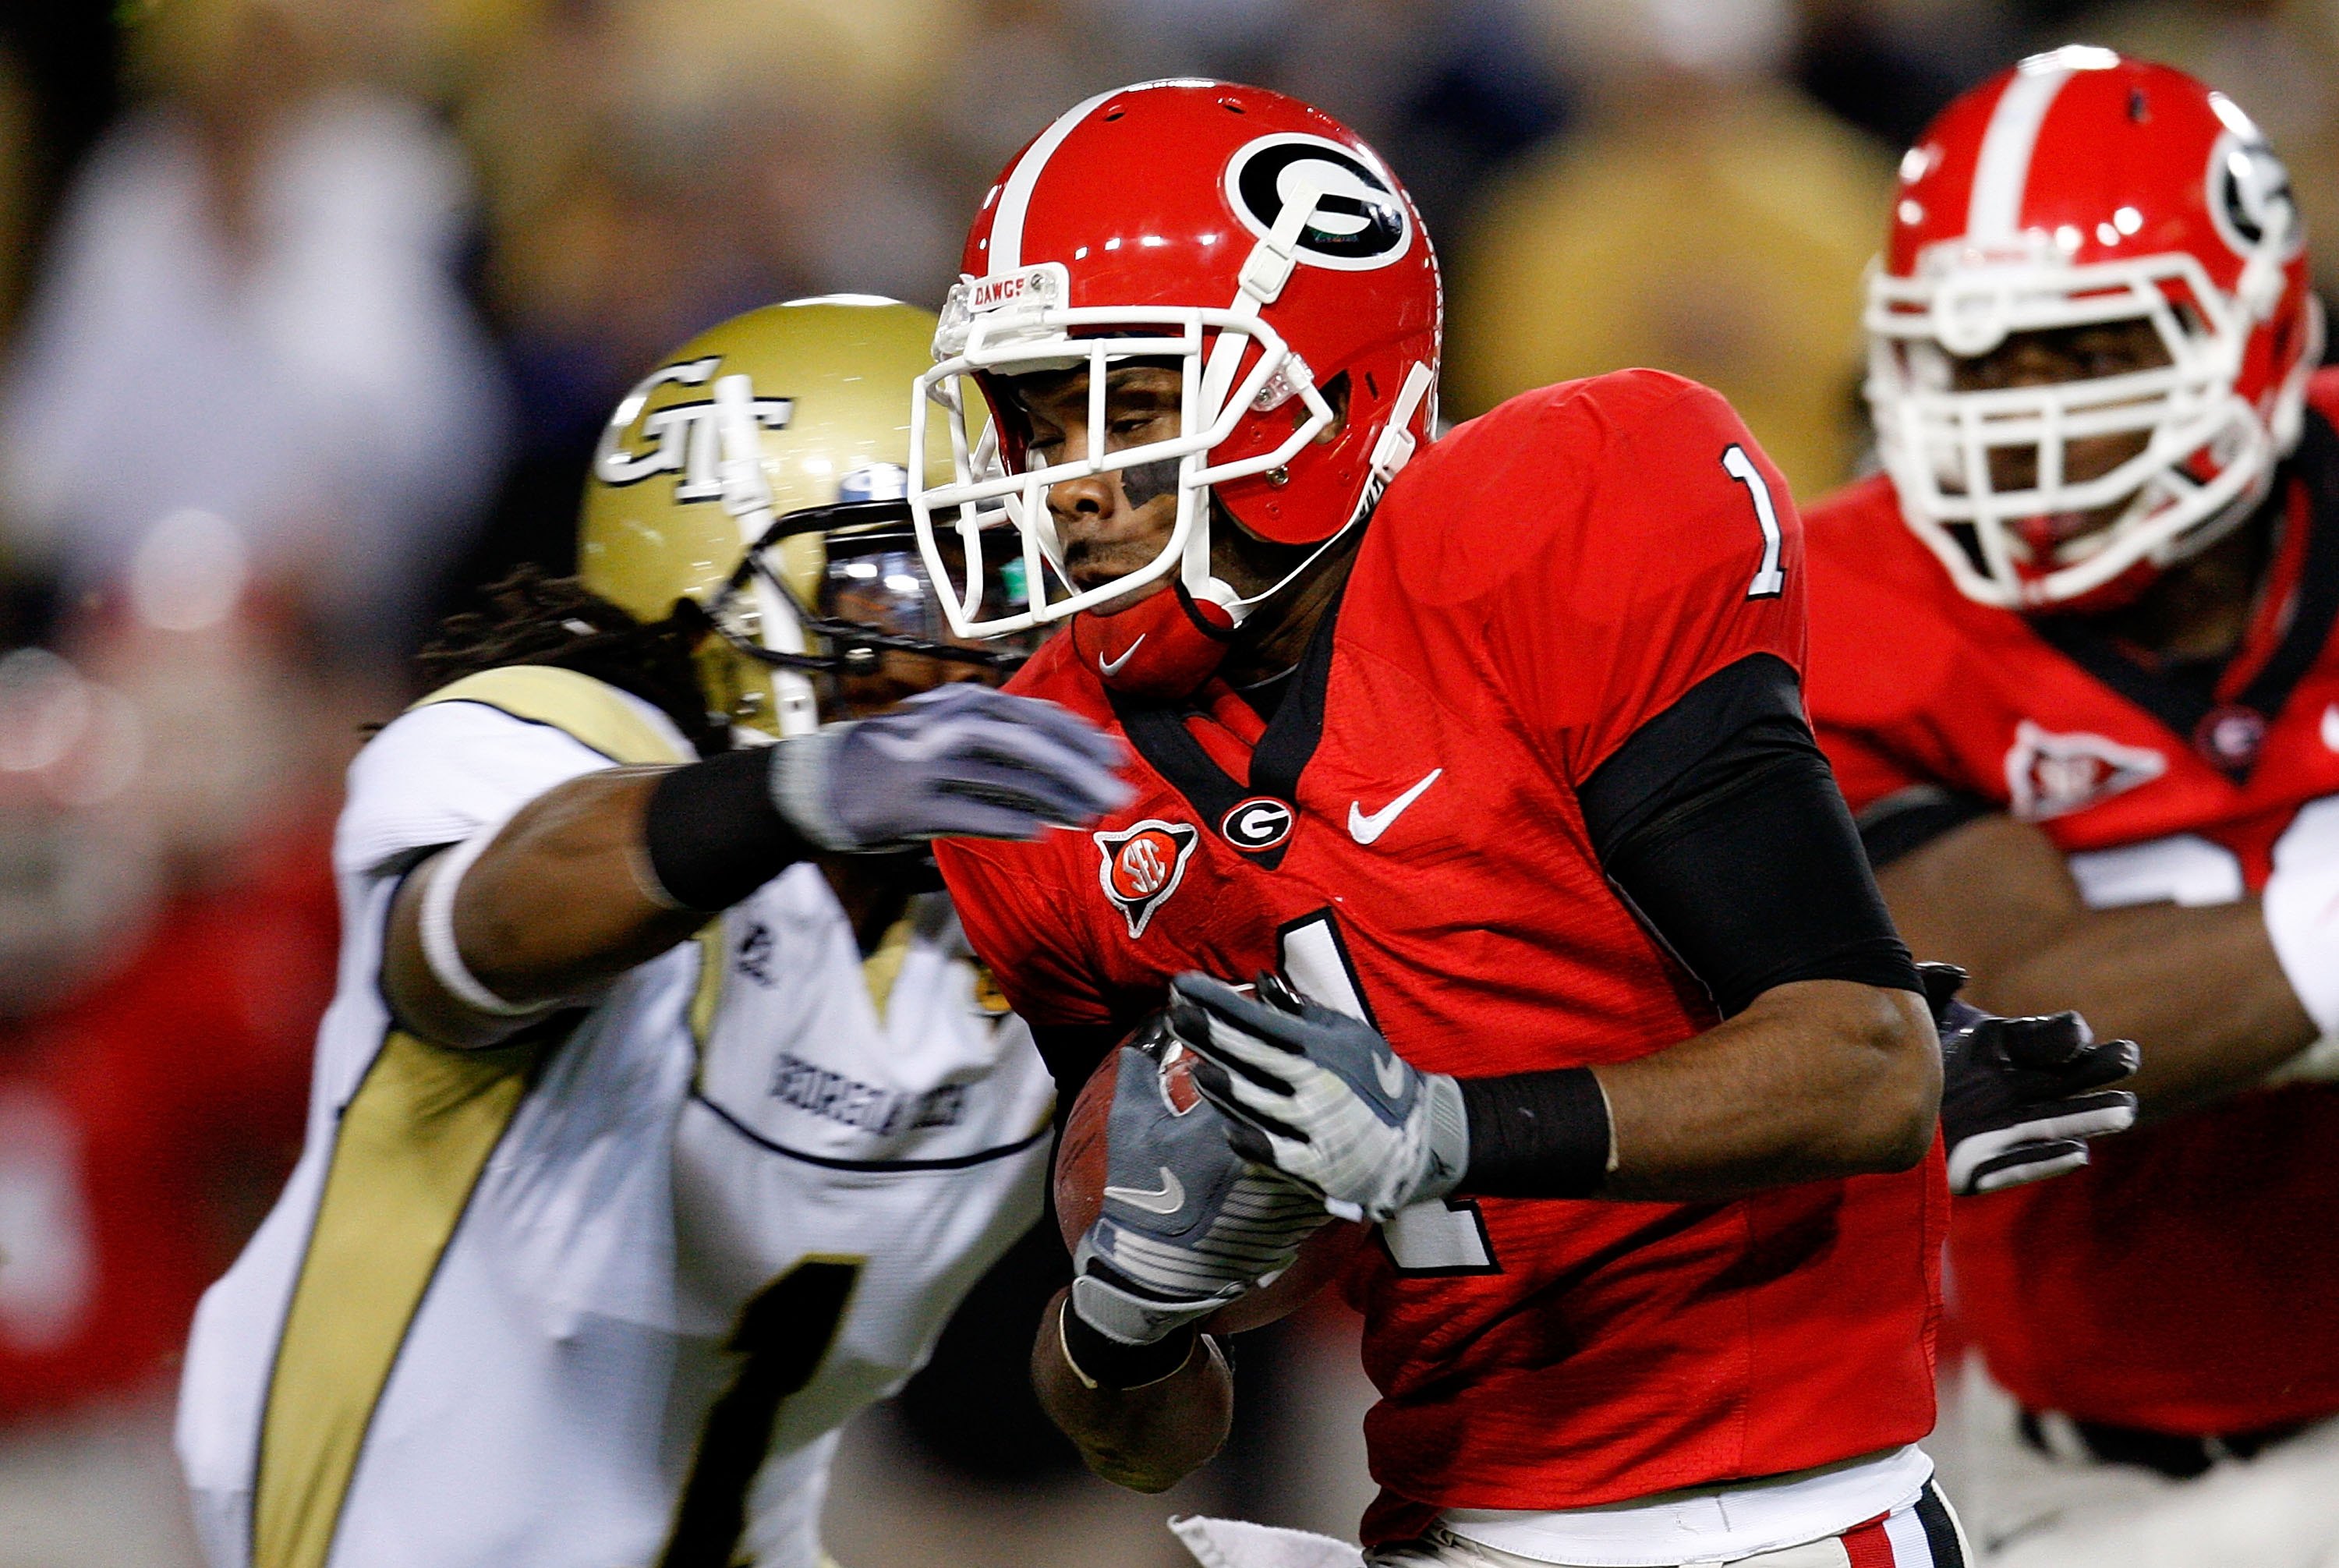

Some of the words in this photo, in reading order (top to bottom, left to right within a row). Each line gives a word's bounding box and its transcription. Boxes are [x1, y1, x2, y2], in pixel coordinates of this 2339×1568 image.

[594, 354, 794, 502] GT
[1721, 443, 1785, 602] 1
[1123, 839, 1165, 892] SEC
[1240, 809, 1293, 838] G
[653, 1252, 867, 1567] 1
